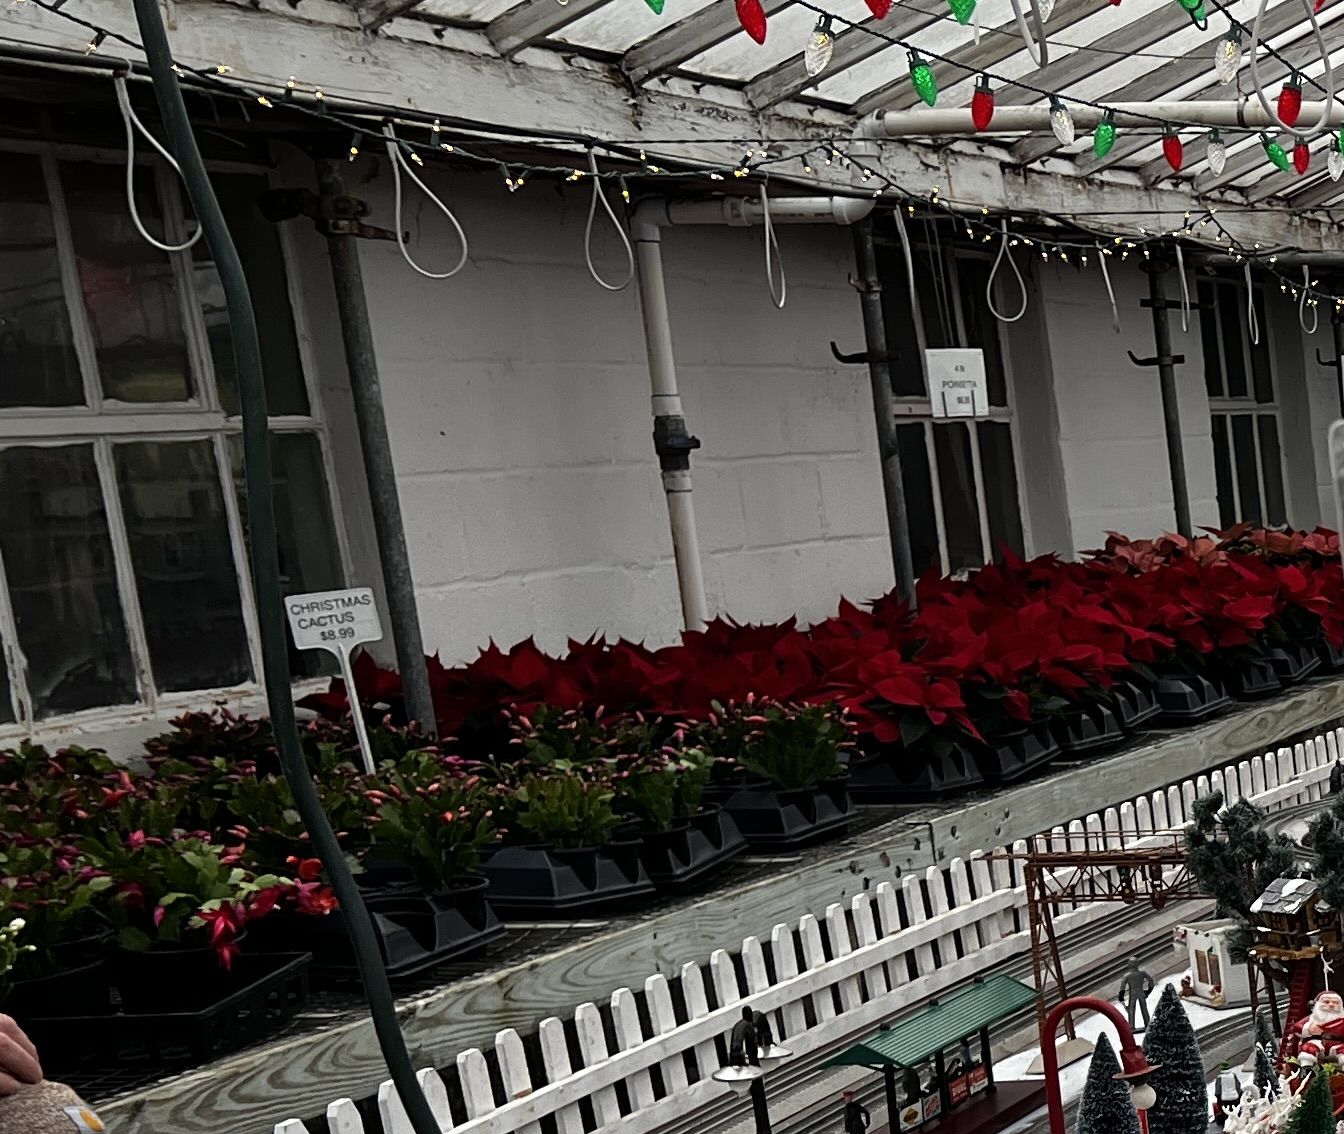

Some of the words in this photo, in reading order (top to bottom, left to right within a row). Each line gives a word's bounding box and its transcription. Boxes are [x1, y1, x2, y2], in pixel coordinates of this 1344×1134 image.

[290, 594, 371, 615] CHRISTMAS
[298, 611, 355, 629] CACTUS
[320, 627, 355, 641] $8.99
